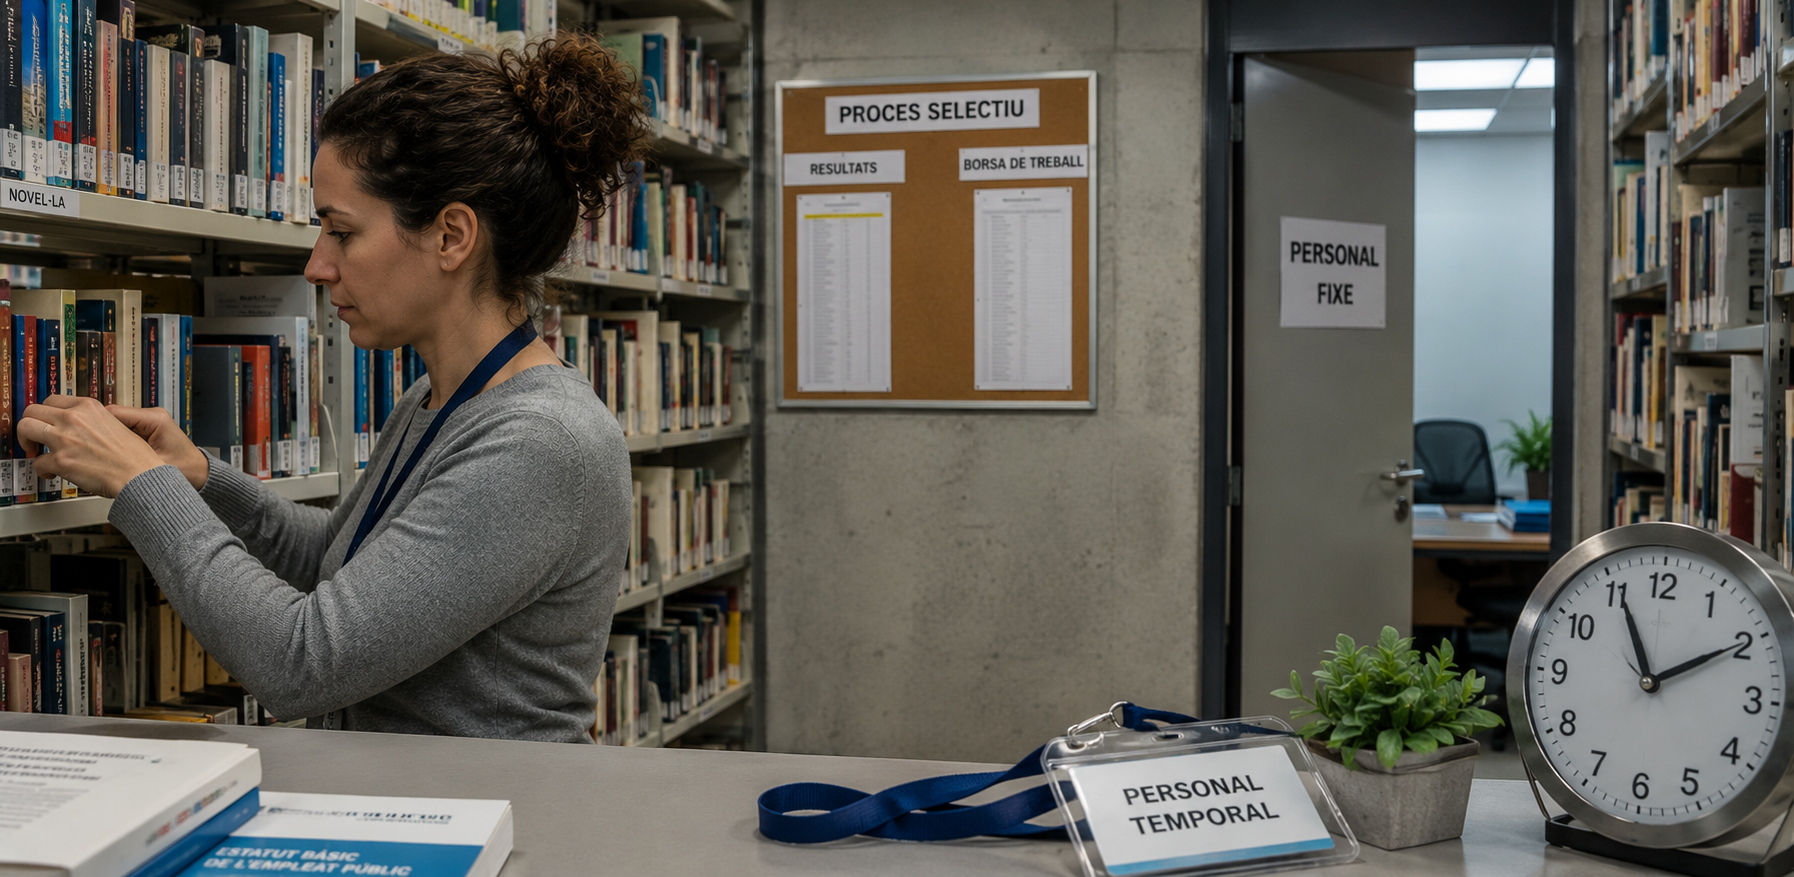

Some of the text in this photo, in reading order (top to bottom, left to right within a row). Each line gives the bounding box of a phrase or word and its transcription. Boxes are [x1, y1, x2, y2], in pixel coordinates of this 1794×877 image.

[839, 99, 1024, 124] PROCES SELECTIU
[810, 161, 878, 176] RESULTATS
[963, 155, 1084, 171] BORSA DE TREBALL
[1290, 240, 1379, 267] PERSONAL
[1317, 282, 1354, 305] FIXE
[1606, 580, 1628, 609] 11
[1649, 571, 1678, 601] 12
[1705, 590, 1715, 618] 1
[1568, 612, 1595, 641] 10
[1733, 631, 1753, 661] 2
[1551, 658, 1568, 685] 9
[1743, 686, 1763, 715] 3
[1559, 709, 1577, 737] 8
[1590, 749, 1607, 777] 7
[1720, 736, 1741, 765] 4
[1122, 774, 1265, 806] PERSONAL
[1632, 772, 1650, 800] 6
[1680, 767, 1700, 797] 5
[1128, 801, 1280, 835] TEMPORAL
[203, 858, 232, 869] DE
[234, 858, 341, 873] L'EMPLEAT
[214, 847, 300, 860] ESTATUT
